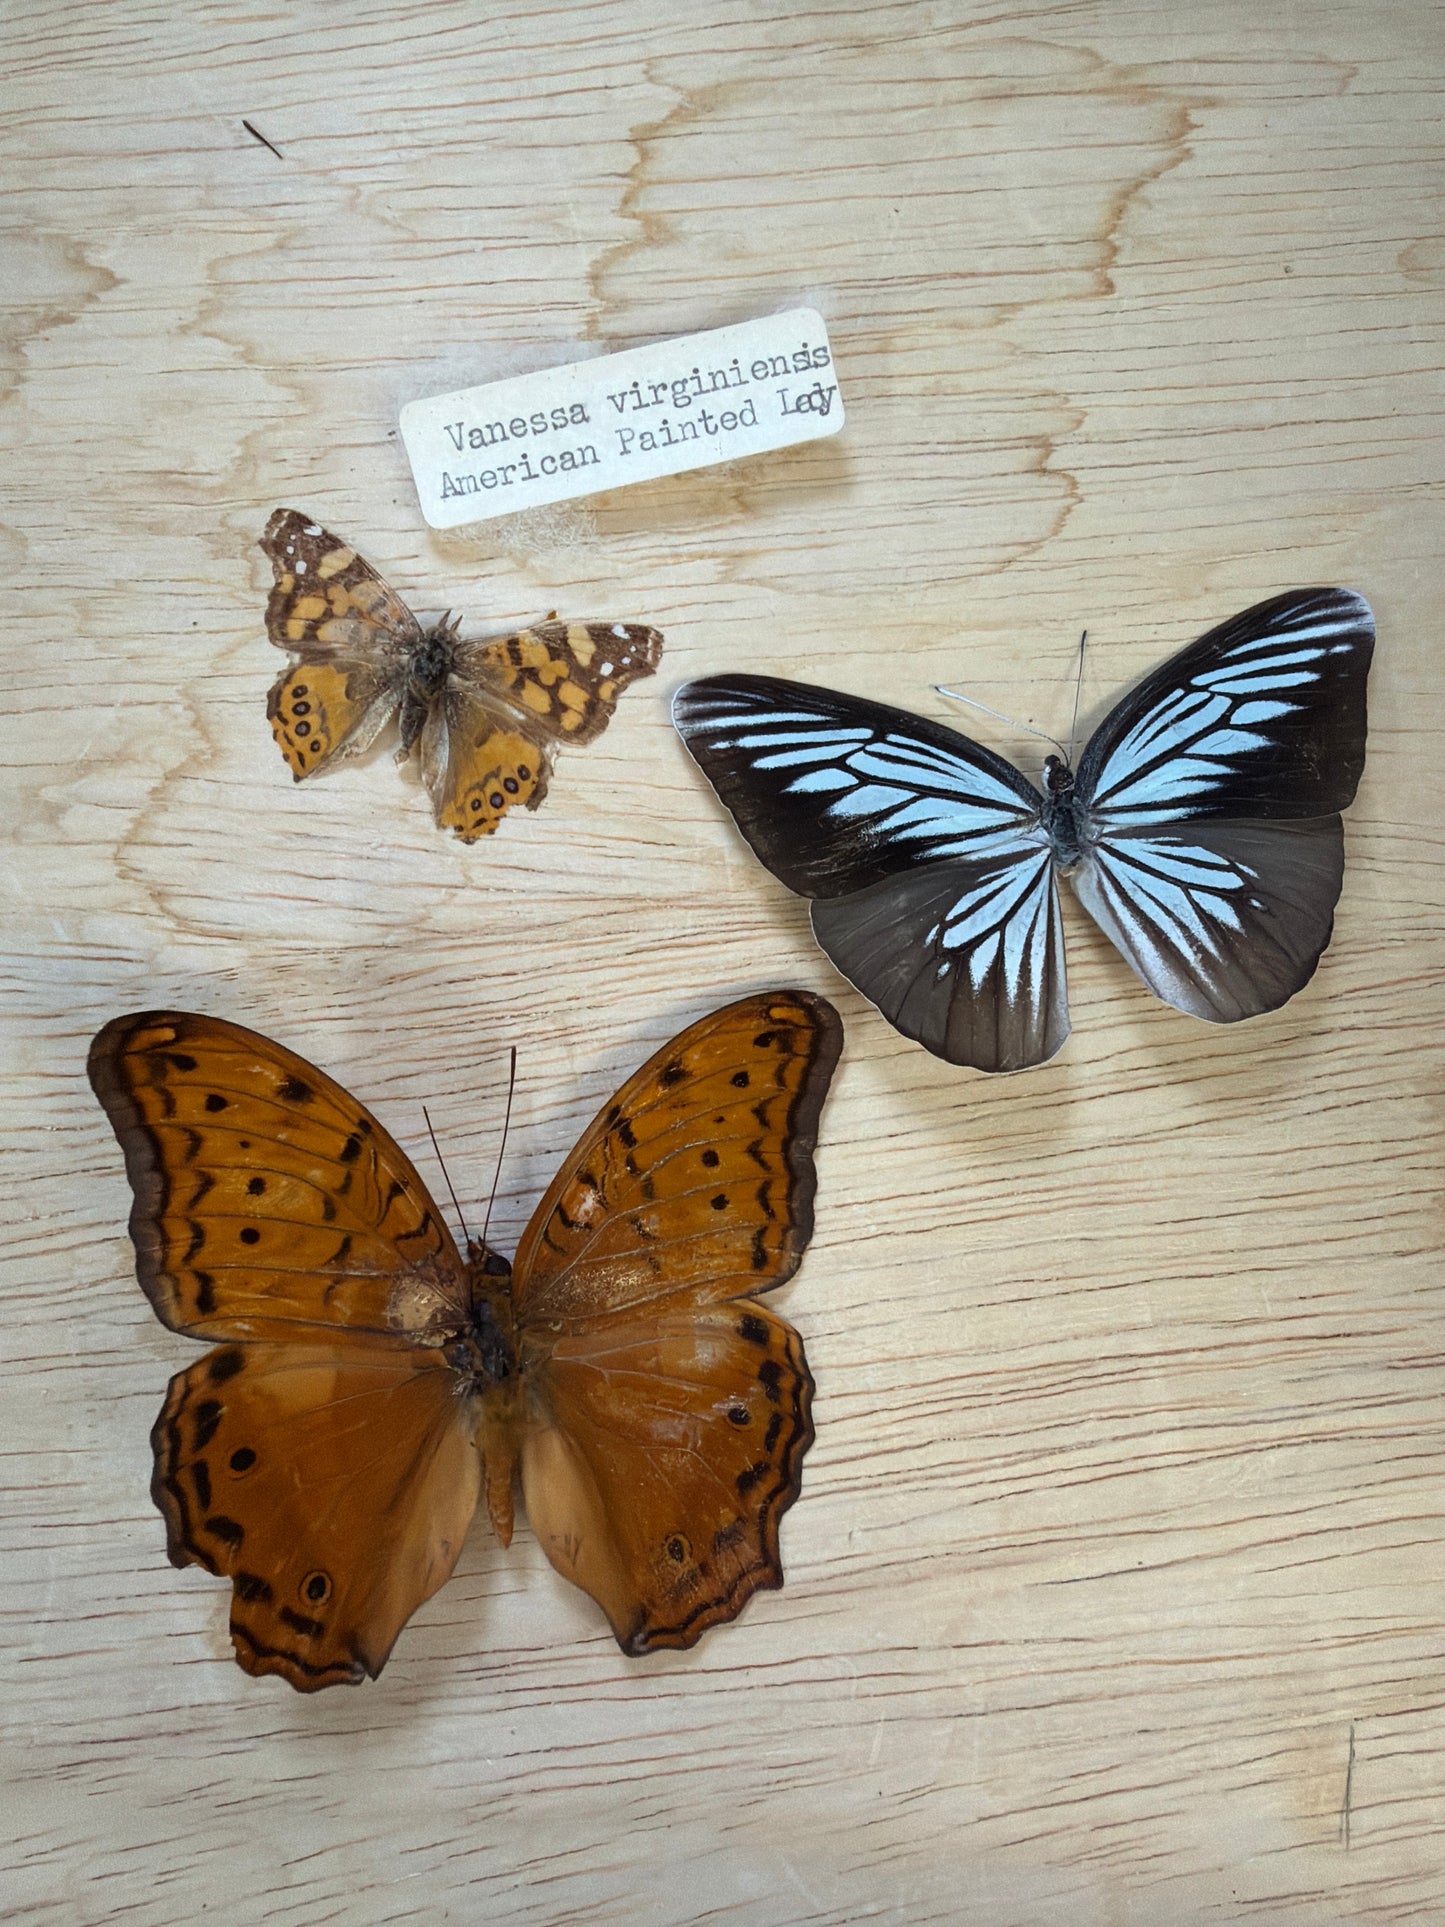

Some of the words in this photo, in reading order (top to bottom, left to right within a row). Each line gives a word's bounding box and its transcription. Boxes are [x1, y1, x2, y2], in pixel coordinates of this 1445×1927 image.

[439, 443, 601, 499] American
[614, 398, 760, 456] Painted
[443, 402, 590, 451] Vanessa
[606, 341, 831, 413] virginiensis
